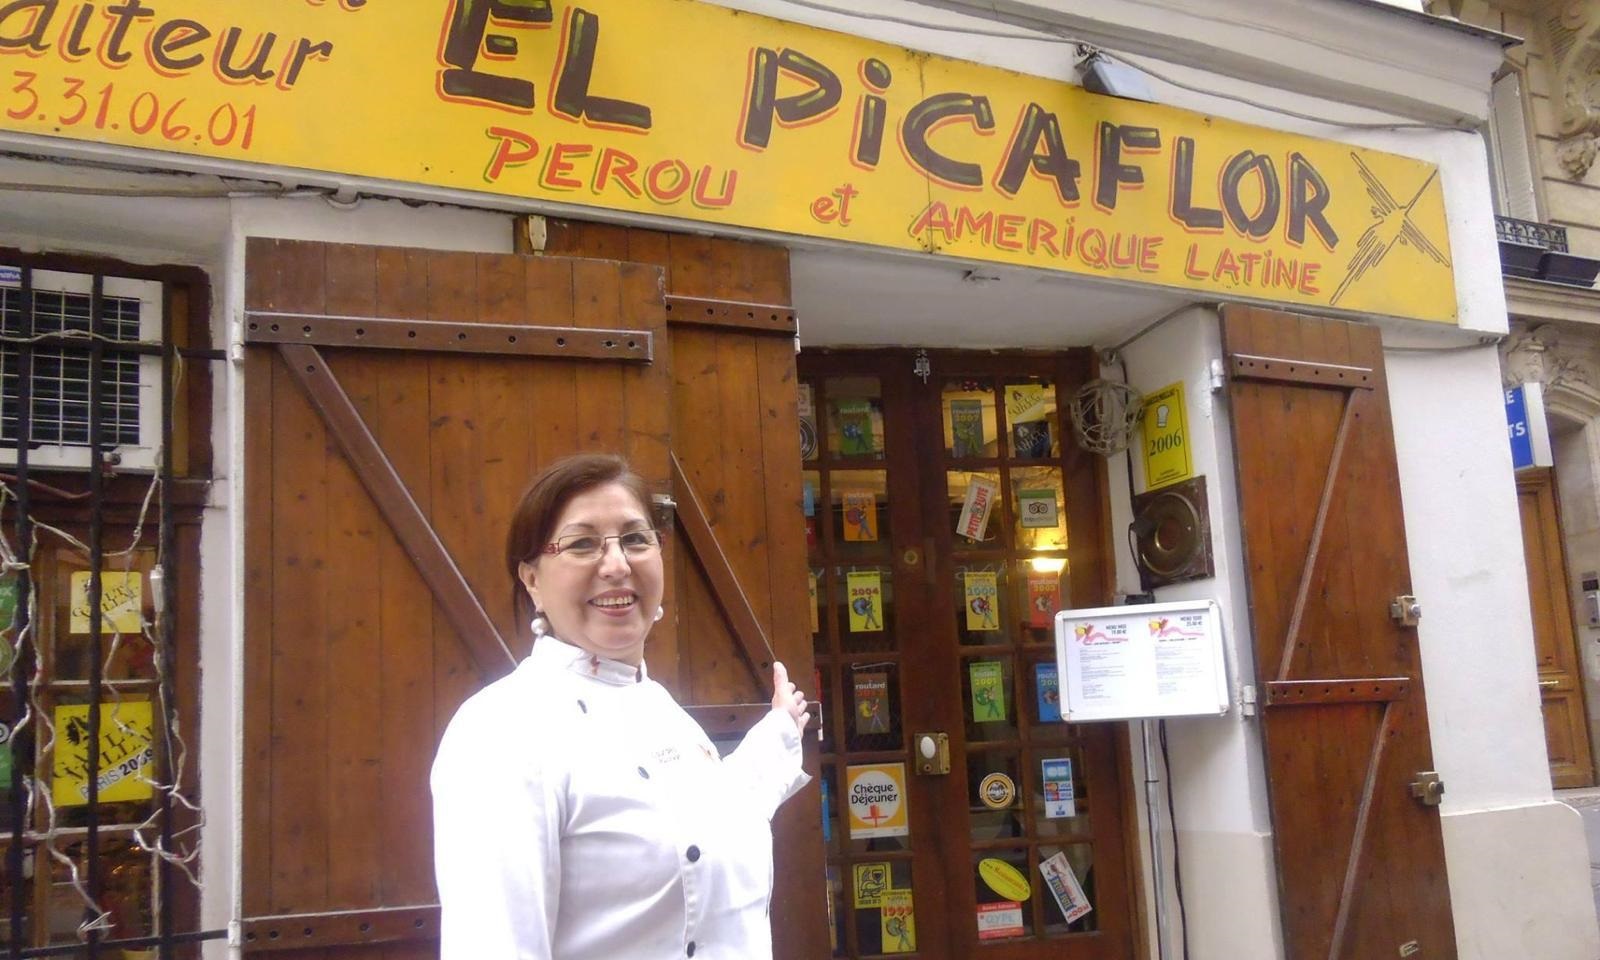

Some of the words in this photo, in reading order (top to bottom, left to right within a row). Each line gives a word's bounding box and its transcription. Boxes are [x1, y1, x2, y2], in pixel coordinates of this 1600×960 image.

[435, 0, 652, 134] EL
[6, 70, 257, 151] 3.31.06.01
[484, 126, 739, 209] PEROU
[809, 181, 856, 225] et
[1149, 427, 1183, 457] 2006
[851, 587, 880, 596] 2004
[855, 681, 887, 691] routard
[851, 793, 898, 805] Déjeuner
[853, 782, 894, 795] Chèque
